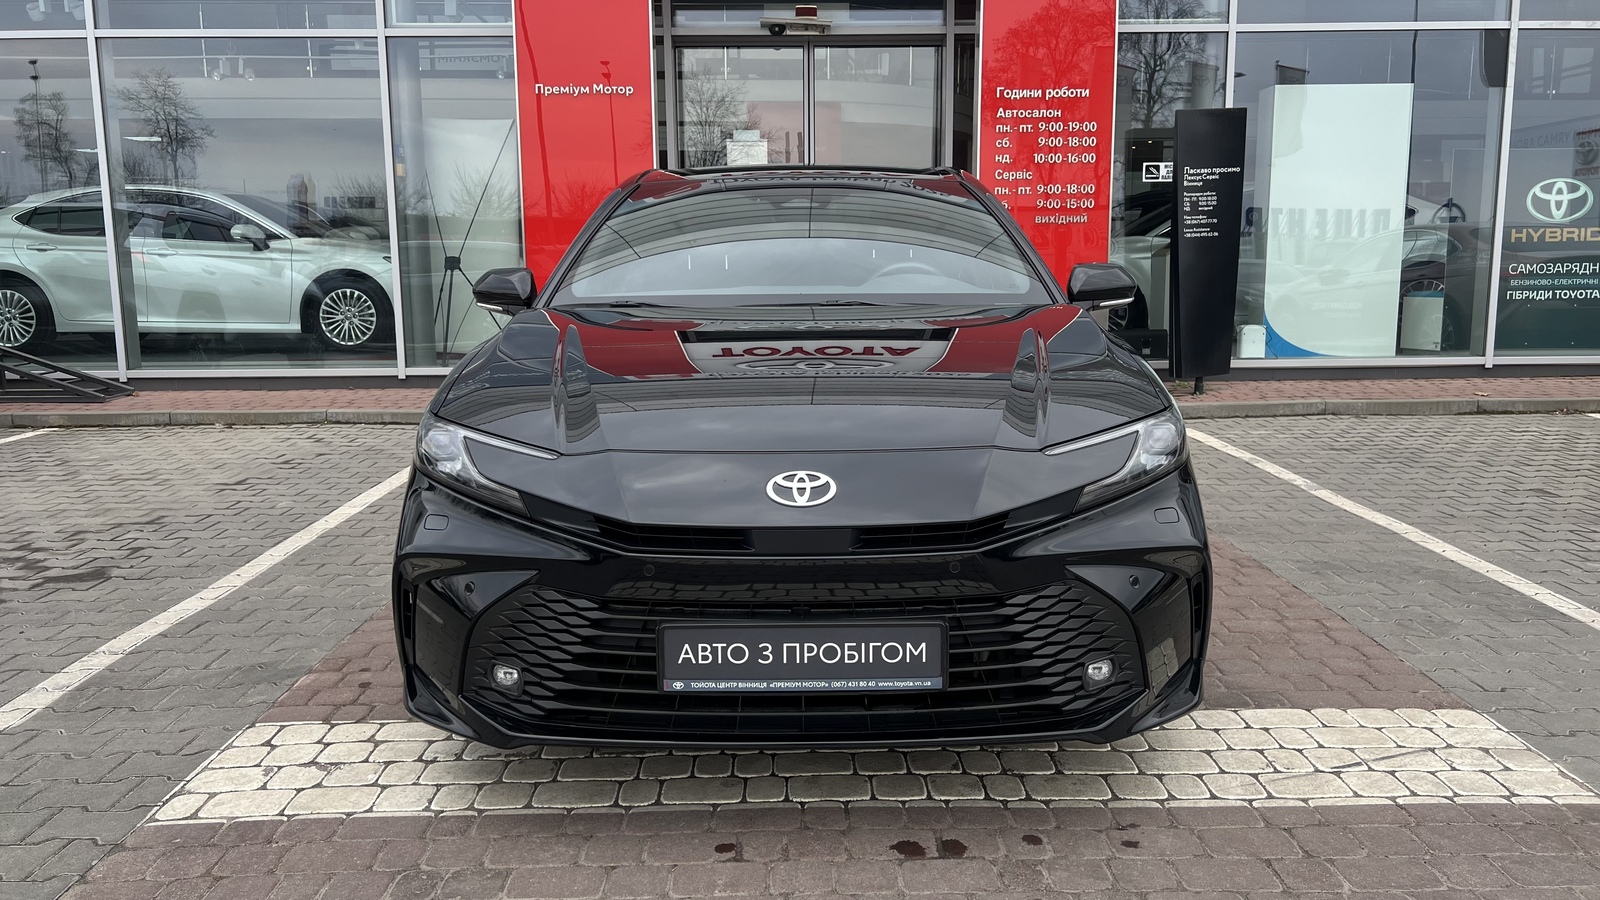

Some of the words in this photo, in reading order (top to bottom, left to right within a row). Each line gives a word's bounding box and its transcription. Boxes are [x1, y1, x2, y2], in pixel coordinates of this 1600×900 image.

[535, 83, 590, 97] Преміум
[592, 83, 634, 97] Мотор
[996, 86, 1042, 100] Години
[1045, 86, 1090, 101] роботи
[996, 107, 1061, 118] Автосалон
[1038, 121, 1097, 133] 9:00-19:00
[995, 137, 1013, 148] сб.
[1038, 136, 1097, 148] 9:00-18:00
[995, 153, 1013, 165] нд.
[1033, 152, 1097, 164] 10:00-16:00
[995, 169, 1033, 182] Сервіс
[1183, 166, 1211, 174] Ласкаво
[1037, 184, 1095, 195] 9:00-18:00
[1036, 198, 1095, 209] 9:00-15:00
[1035, 212, 1088, 224] вихідний
[1508, 262, 1600, 275] САМОЗАРЯДН
[1510, 278, 1599, 286] БЕНЗИНОВО-ЕЛЕКТРИЧНІ
[1506, 290, 1553, 301] ГІБРИДИ
[1554, 289, 1600, 299] TOYOTA
[677, 642, 750, 665] АВТО
[782, 641, 927, 664] ПРОБІГОМ
[690, 681, 716, 689] ТОЙОТА
[716, 681, 738, 689] ЦЕНТР
[738, 681, 768, 689] ВІННИЦЯ
[830, 681, 847, 689] (067)
[877, 680, 932, 688] www.toyota.vn.ua
